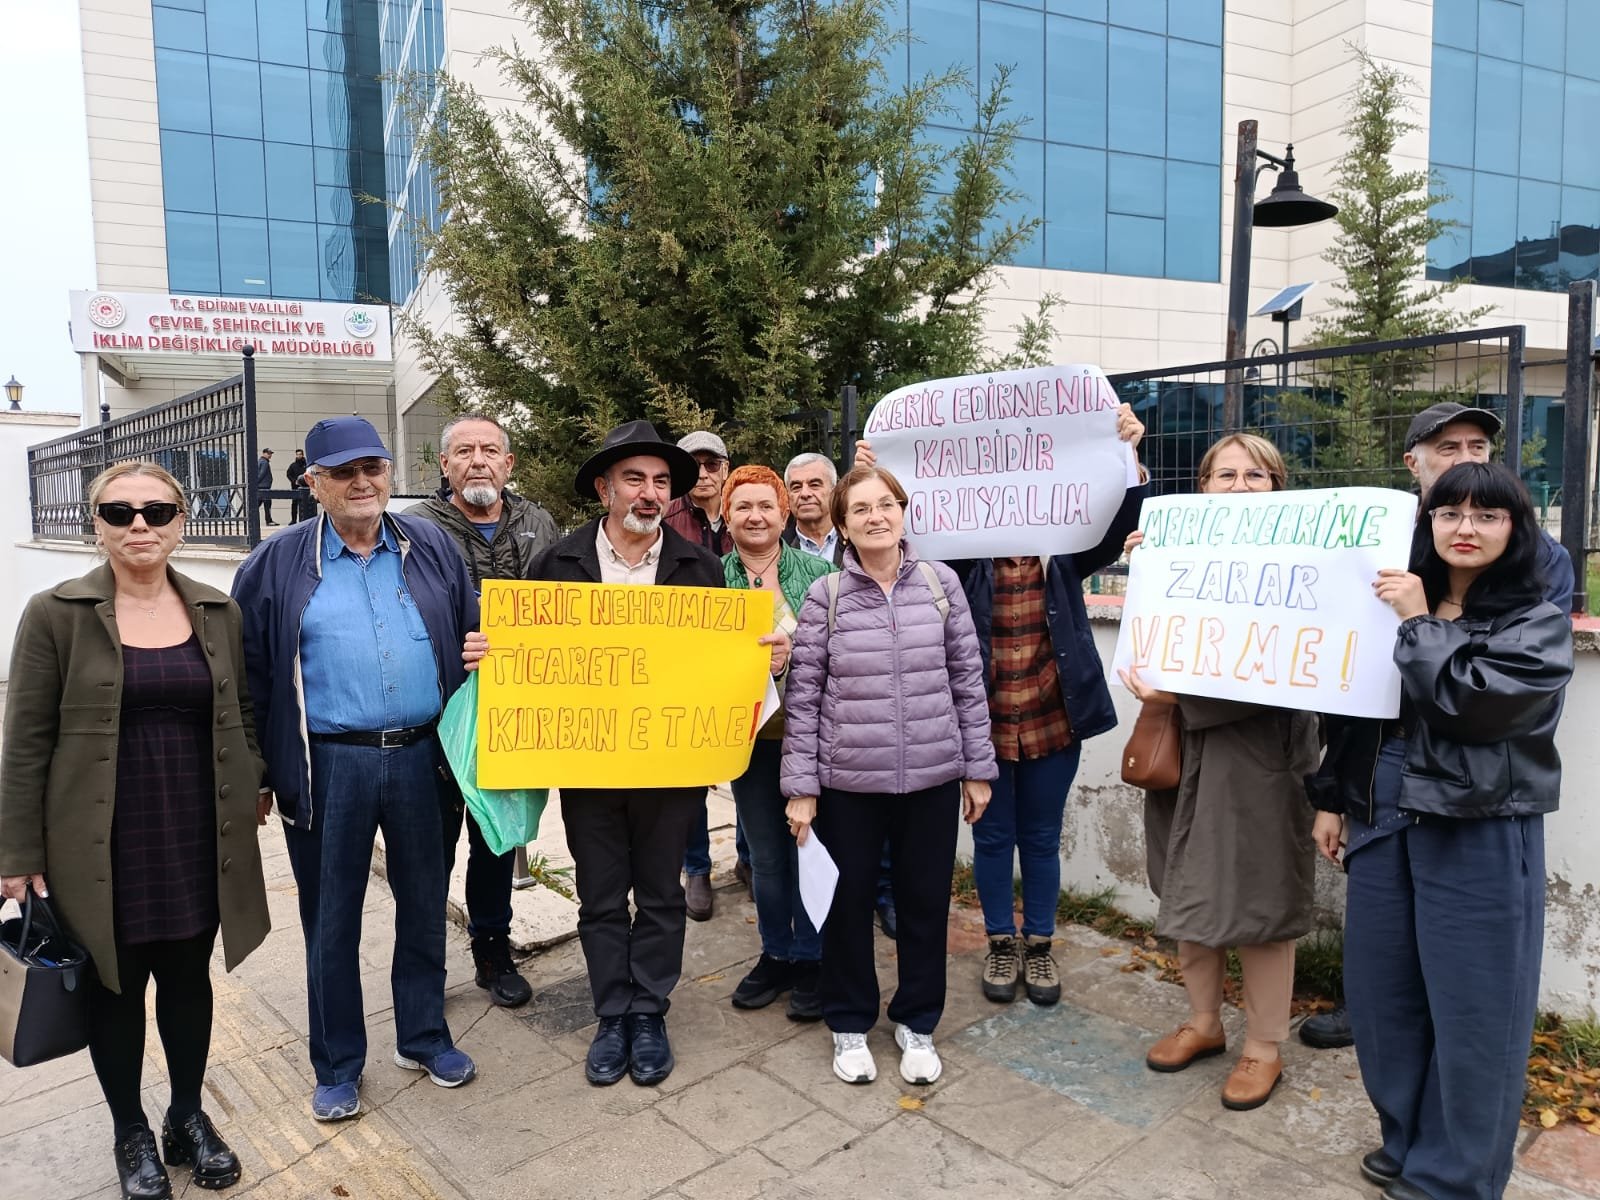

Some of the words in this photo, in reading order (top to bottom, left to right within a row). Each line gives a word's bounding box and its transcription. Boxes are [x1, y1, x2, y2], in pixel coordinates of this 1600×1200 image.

[149, 315, 208, 332] ÇEVRE,
[213, 317, 301, 334] ŞEHİRCİLİK
[305, 322, 325, 334] VE
[170, 299, 194, 311] T.C.
[198, 298, 246, 313] EDİRNE
[249, 301, 302, 315] VALİLİĞİ
[93, 331, 143, 349] İKLİM
[272, 338, 374, 357] MÜDÜRLÜĞÜ
[868, 388, 945, 433] MERİÇ
[915, 427, 1054, 479] KALBİDİR
[902, 483, 1091, 536] ORUYALIM
[486, 583, 582, 627] MERİÇ
[590, 587, 746, 631] NEHRİMİZİ
[1166, 561, 1319, 610] ZARAR
[487, 643, 649, 686] TİCARETE
[488, 707, 617, 753] KURBAN
